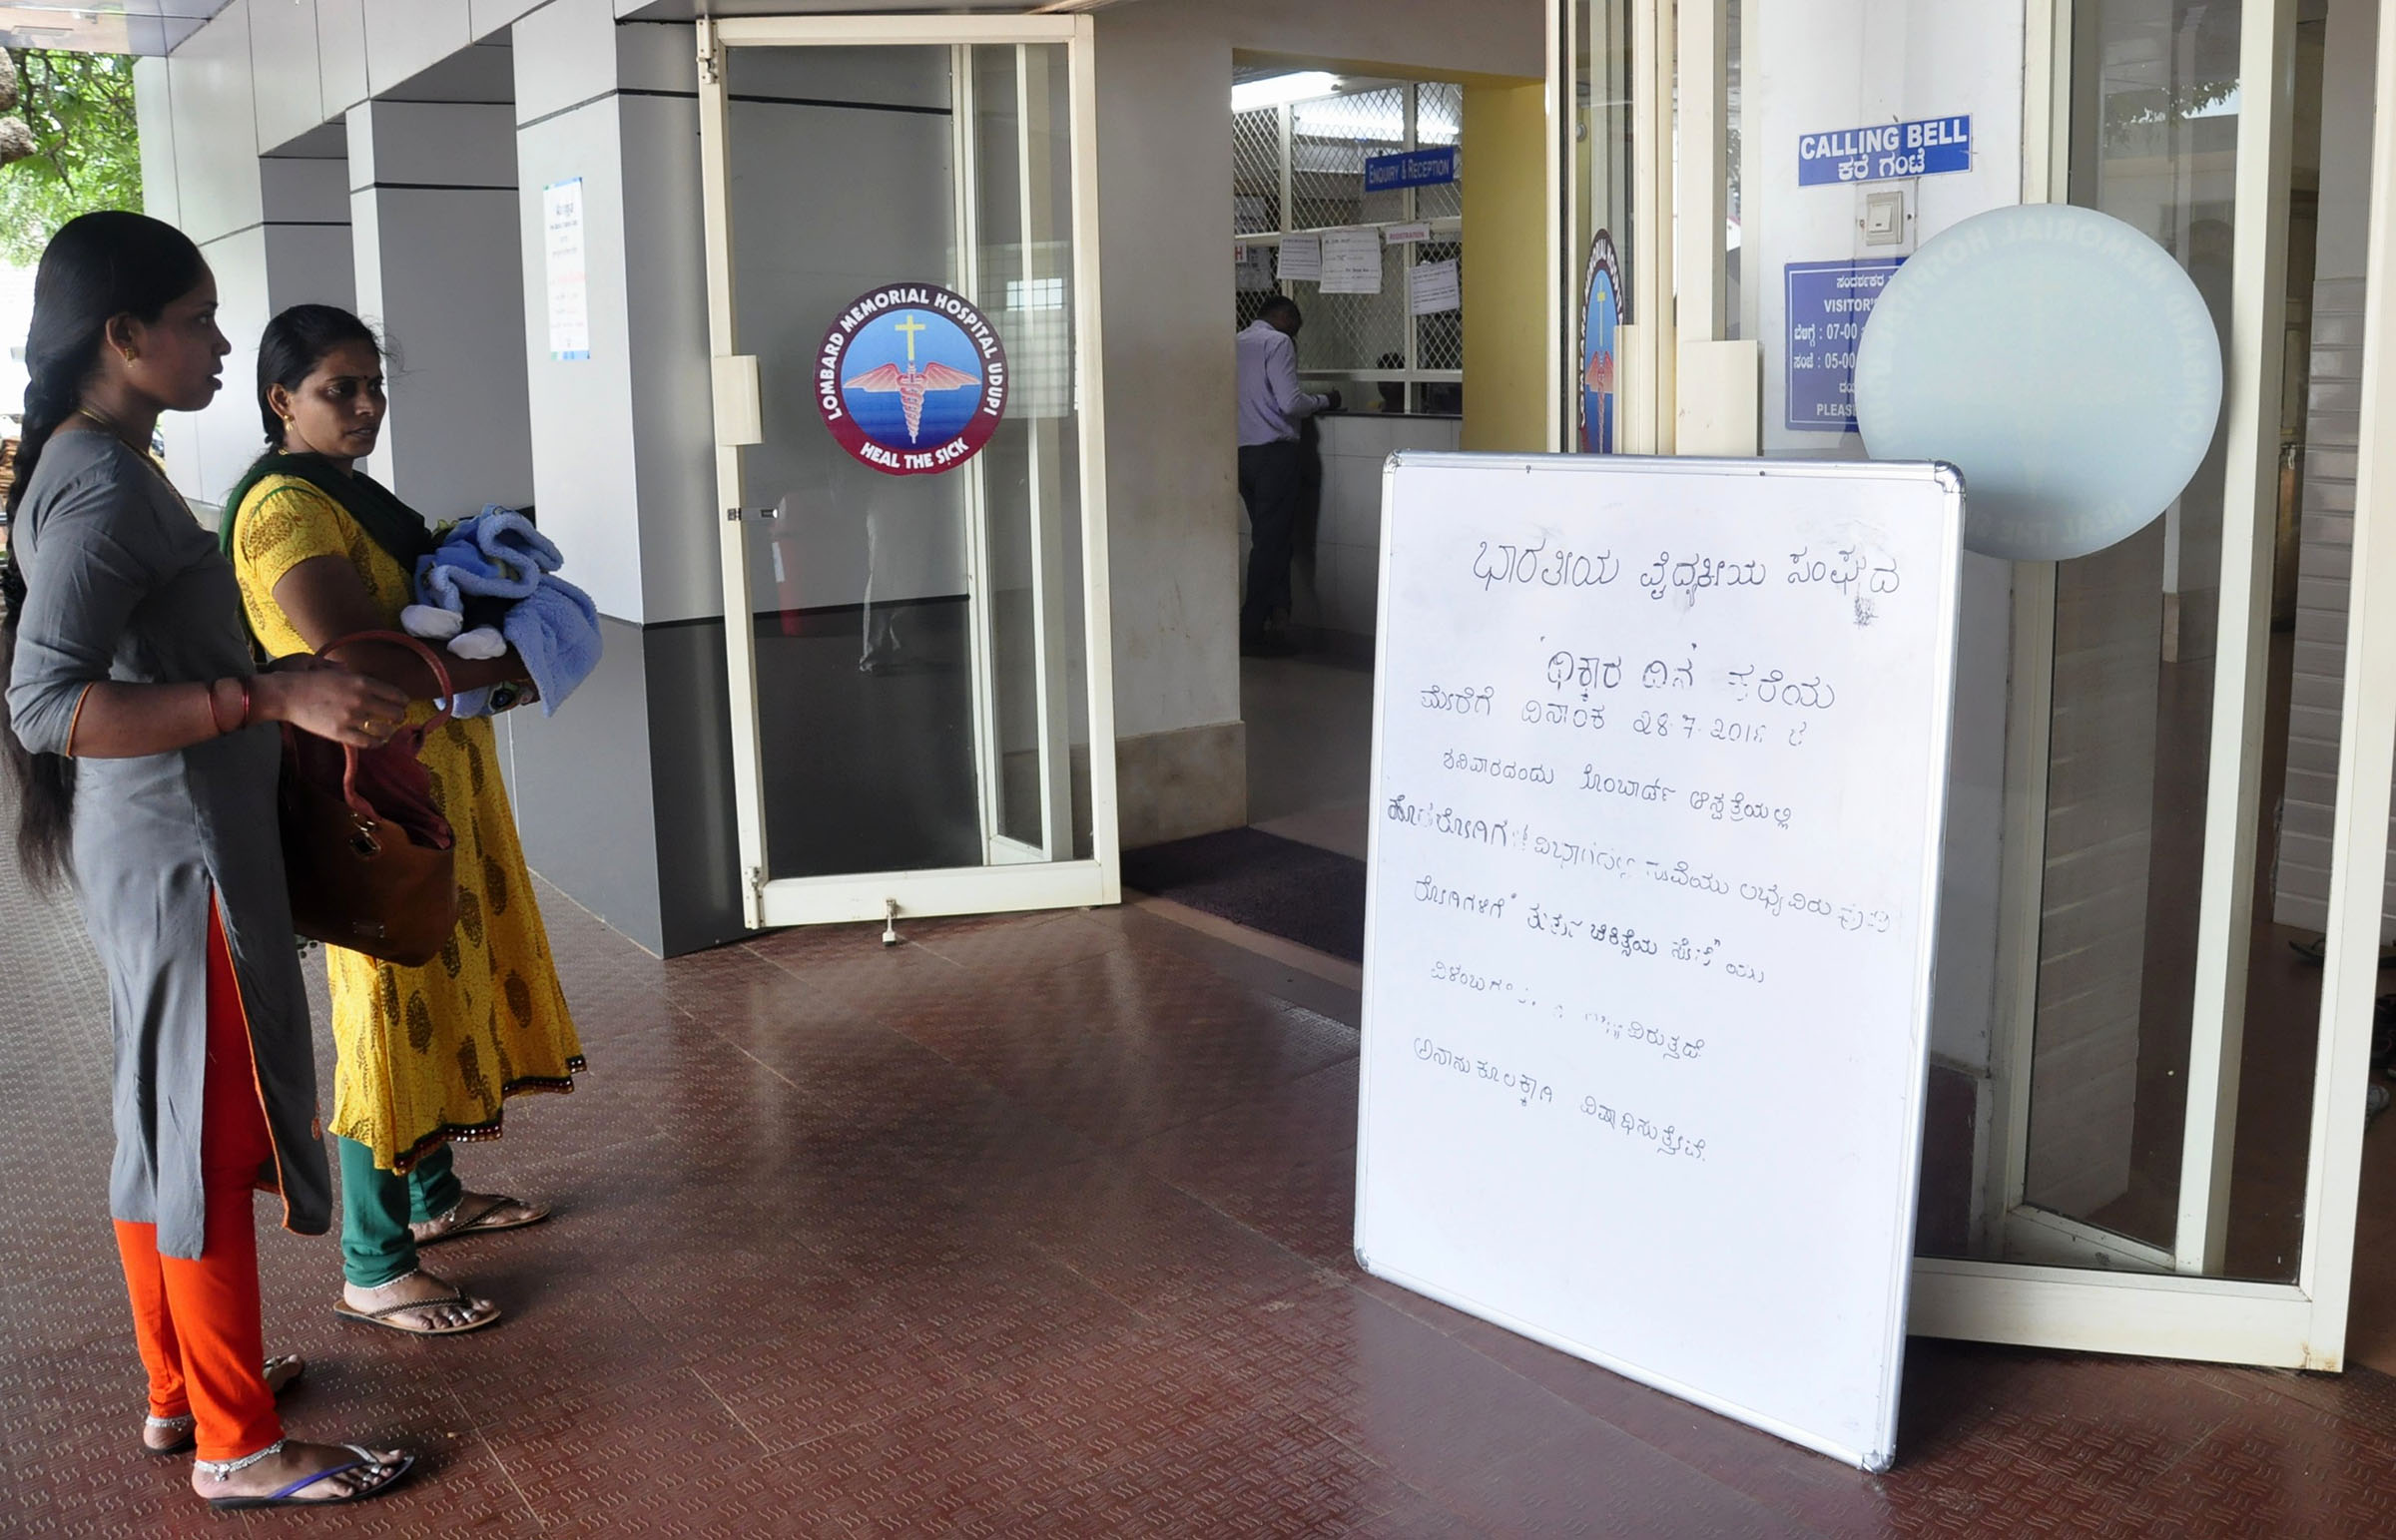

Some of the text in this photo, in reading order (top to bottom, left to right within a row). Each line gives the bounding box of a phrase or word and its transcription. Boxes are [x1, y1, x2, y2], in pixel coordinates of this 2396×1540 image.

[1801, 119, 1968, 160] CALLING BELL
[1408, 159, 1451, 180] RECEPTION
[1838, 147, 1925, 181] ಕರೆ ಗಂಟೆ
[1826, 323, 1858, 340] 07-00
[820, 287, 1004, 421] LOMBARD MEMORIAL HOSPITAL UDUPI
[1824, 352, 1855, 369] 05-00
[860, 436, 969, 469] HEAL THE SICK
[1474, 538, 1619, 591] ಭಾರತೀಯ
[1639, 551, 1766, 607] ವೈದ್ಯಕೀಯ
[1443, 749, 1554, 785] ಶನಿವಾರದಂದು
